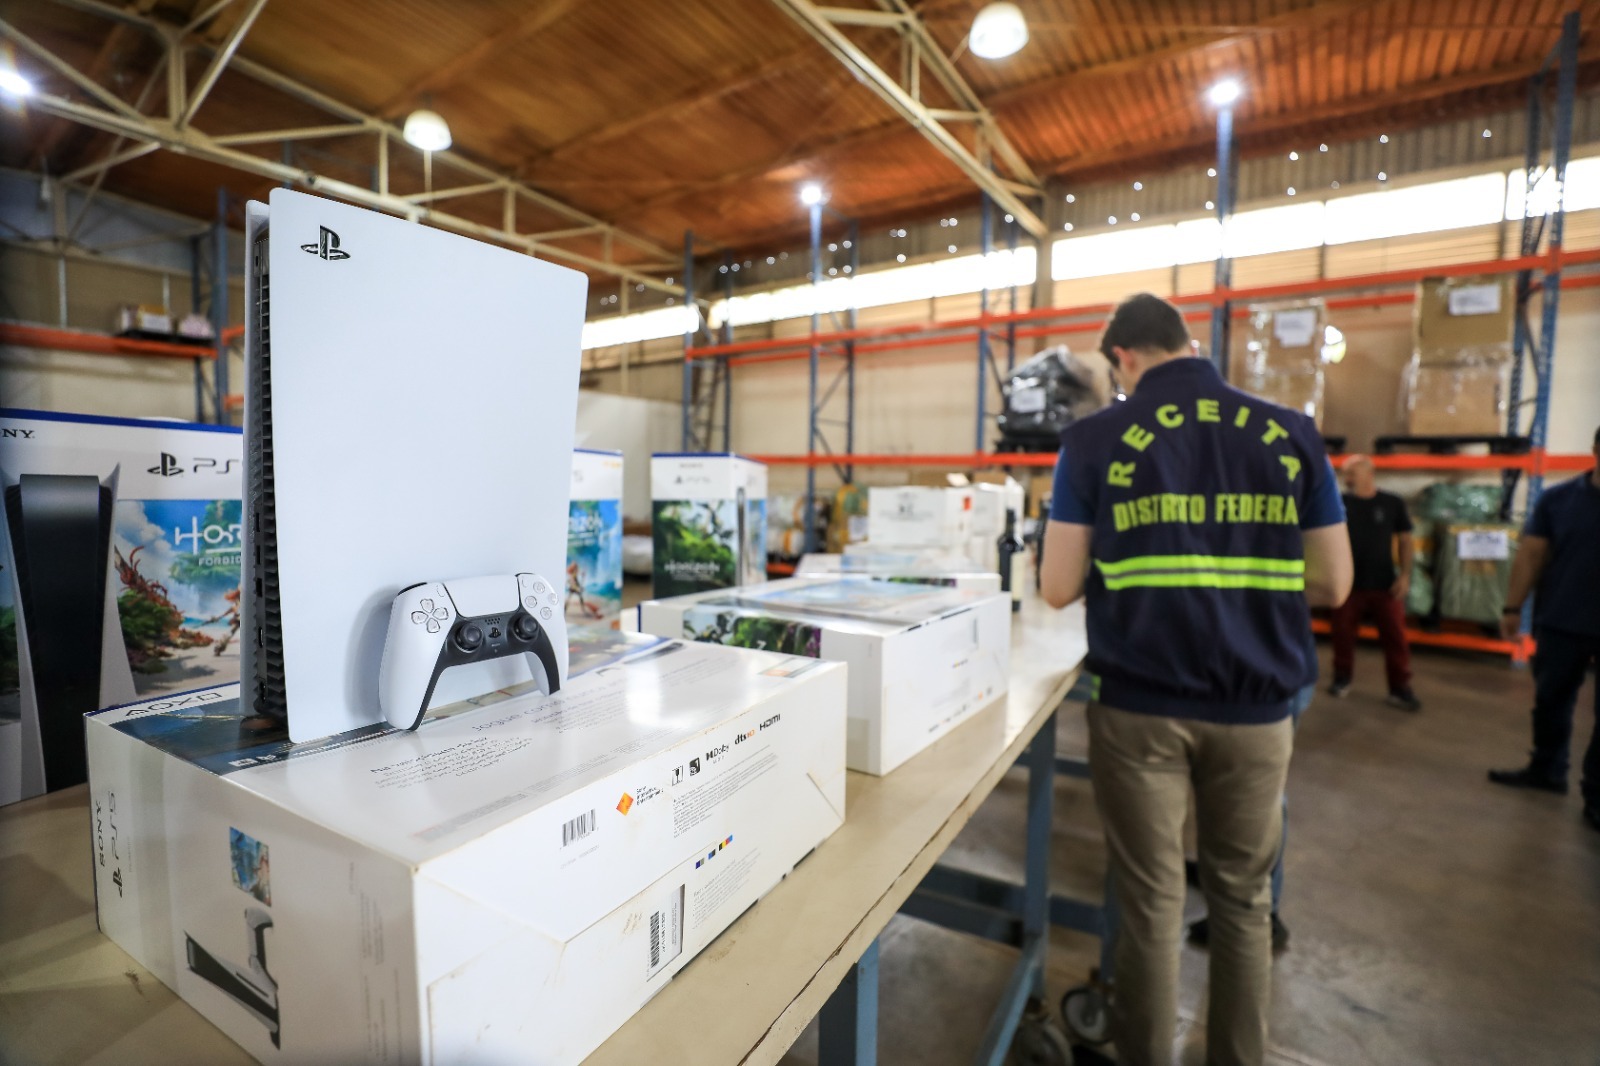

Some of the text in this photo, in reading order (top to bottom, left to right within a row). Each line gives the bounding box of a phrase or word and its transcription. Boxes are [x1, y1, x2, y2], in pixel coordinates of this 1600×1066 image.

[1107, 399, 1301, 487] RECEITA
[1112, 492, 1206, 532] DISTRTO
[759, 713, 781, 731] HDMI
[96, 799, 105, 868] SONY
